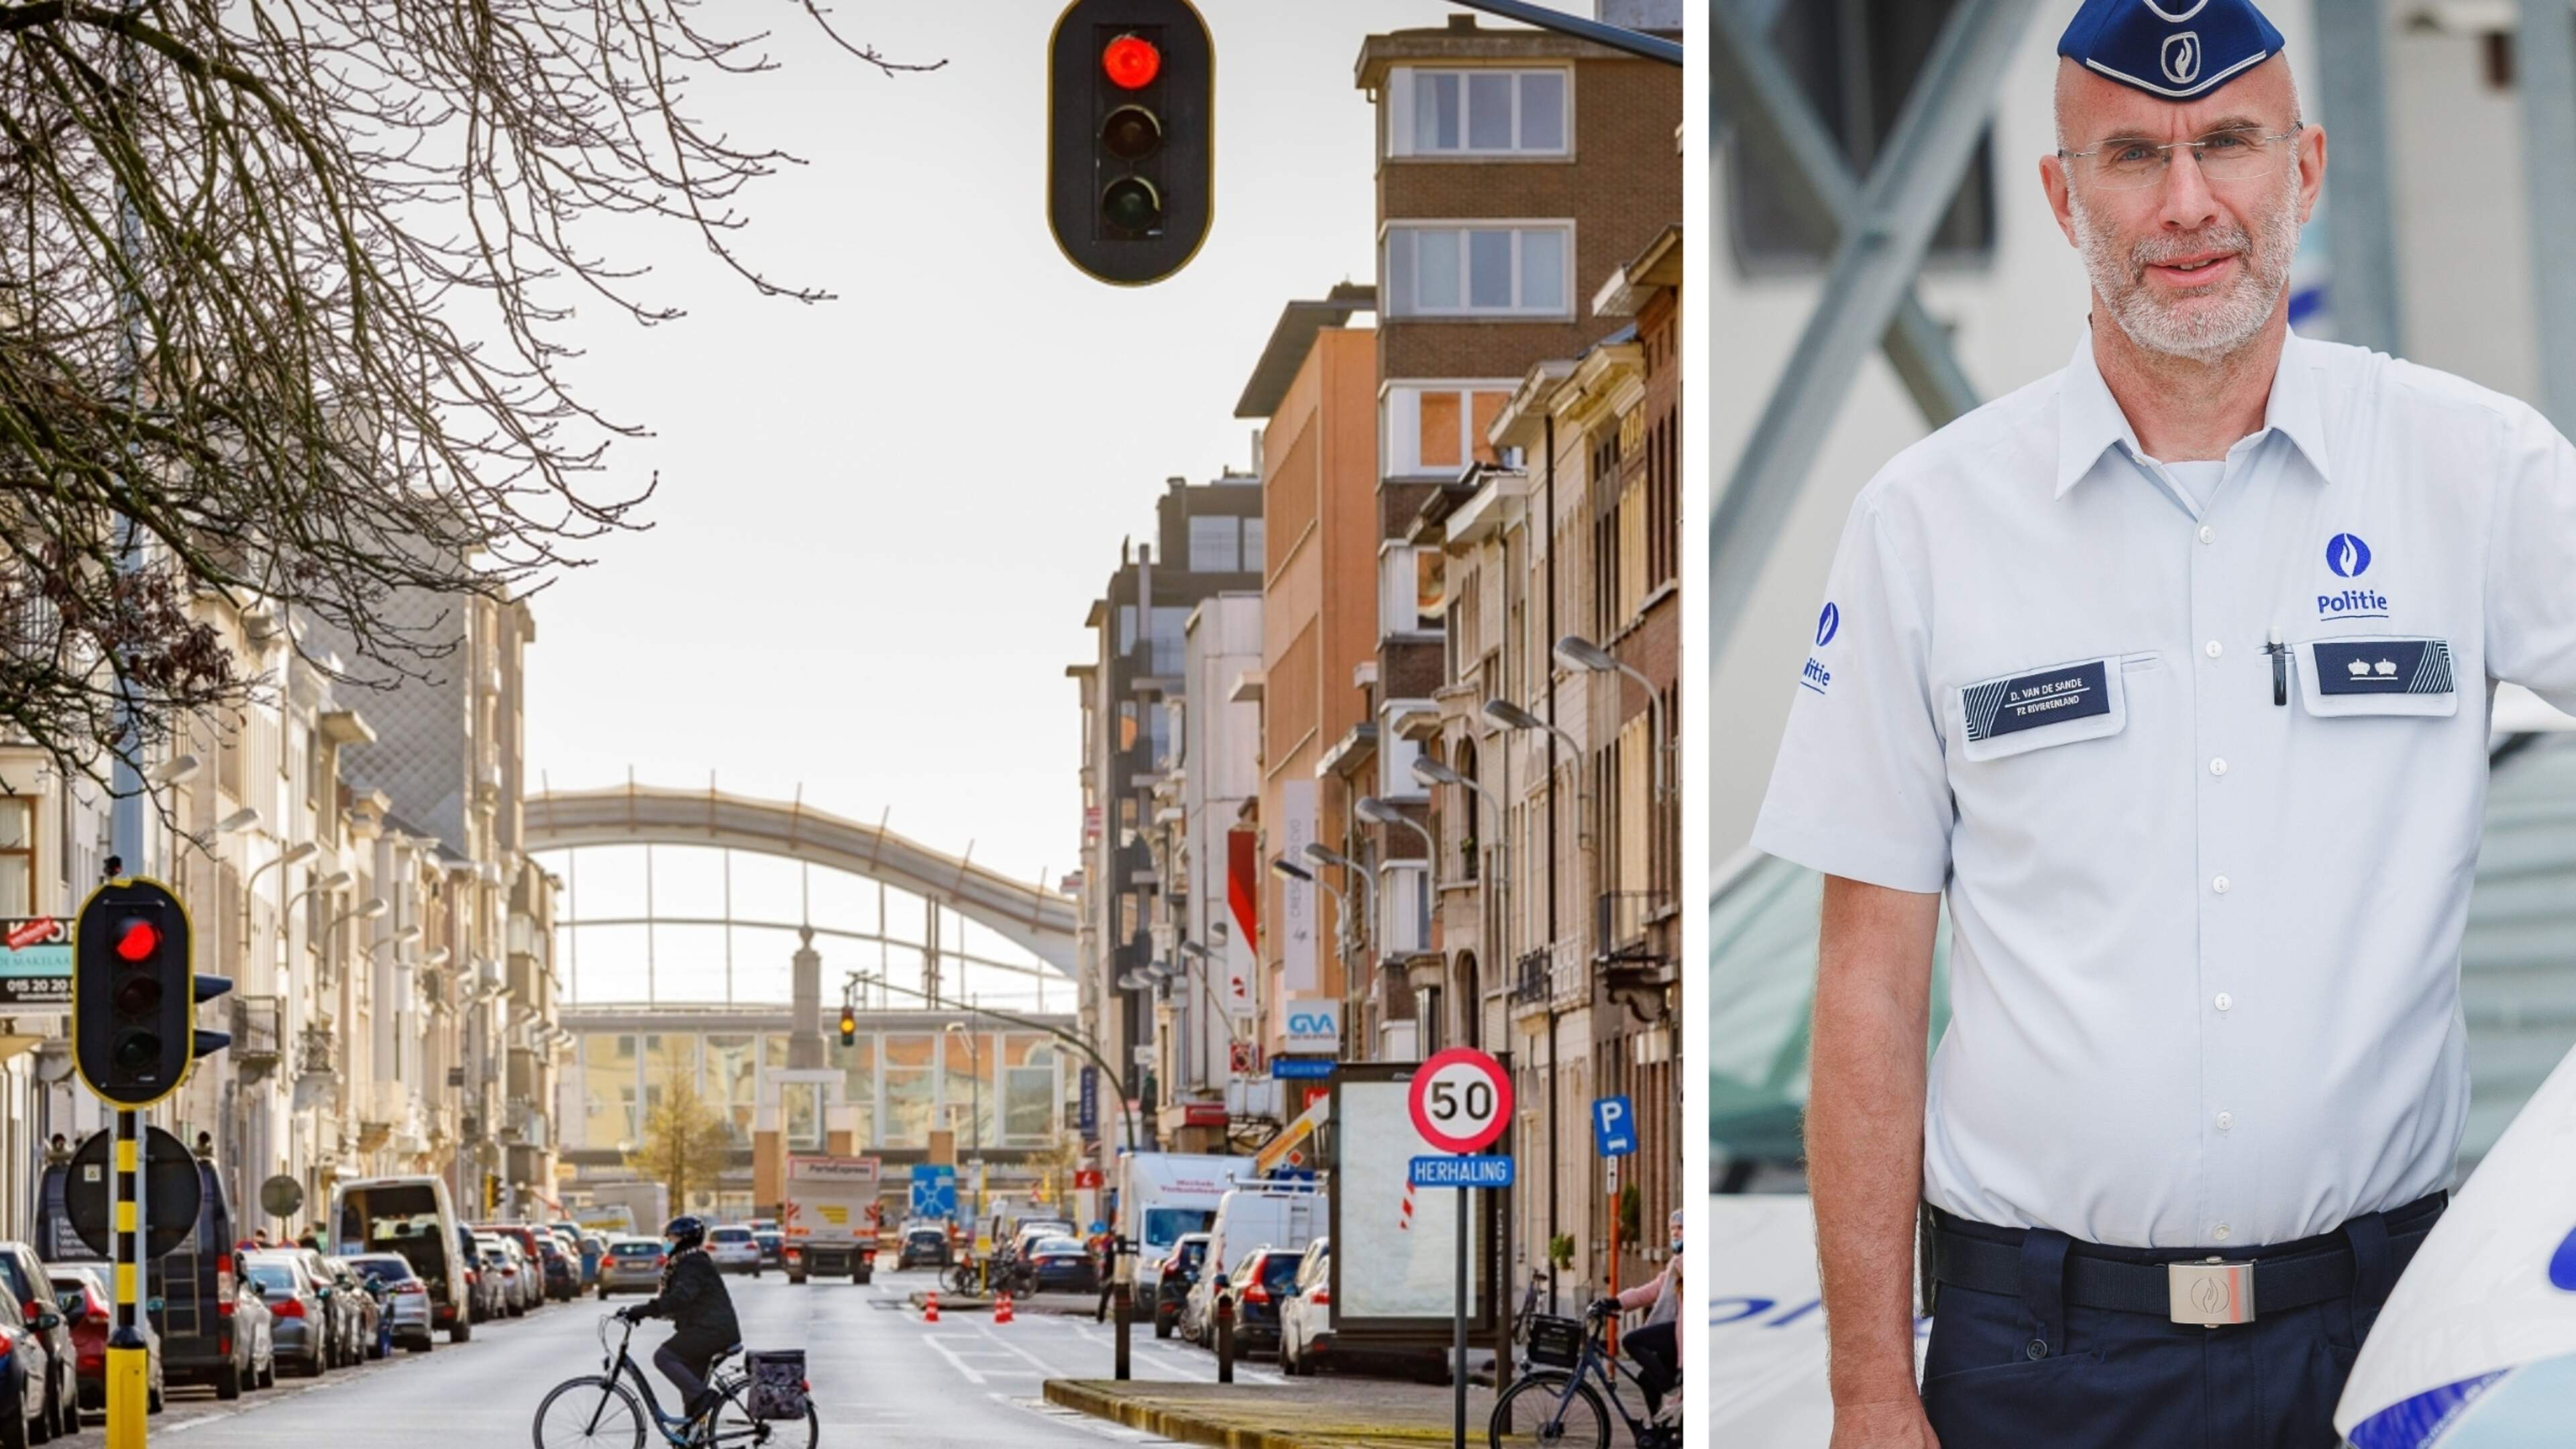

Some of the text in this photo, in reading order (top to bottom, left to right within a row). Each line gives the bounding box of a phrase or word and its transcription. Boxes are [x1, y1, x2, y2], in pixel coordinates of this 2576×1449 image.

[2318, 590, 2388, 613] Politie
[2010, 678, 2083, 701] D. VAN DE SANDE
[2017, 695, 2080, 716] PZ RIVIERENLAND
[1289, 819, 1301, 843] CVO
[32, 979, 49, 992] 20
[51, 979, 68, 992] 20
[1289, 1013, 1335, 1034] GVA
[1432, 1081, 1491, 1121] 50
[1601, 1101, 1623, 1133] P
[1414, 1161, 1506, 1182] HERHALING
